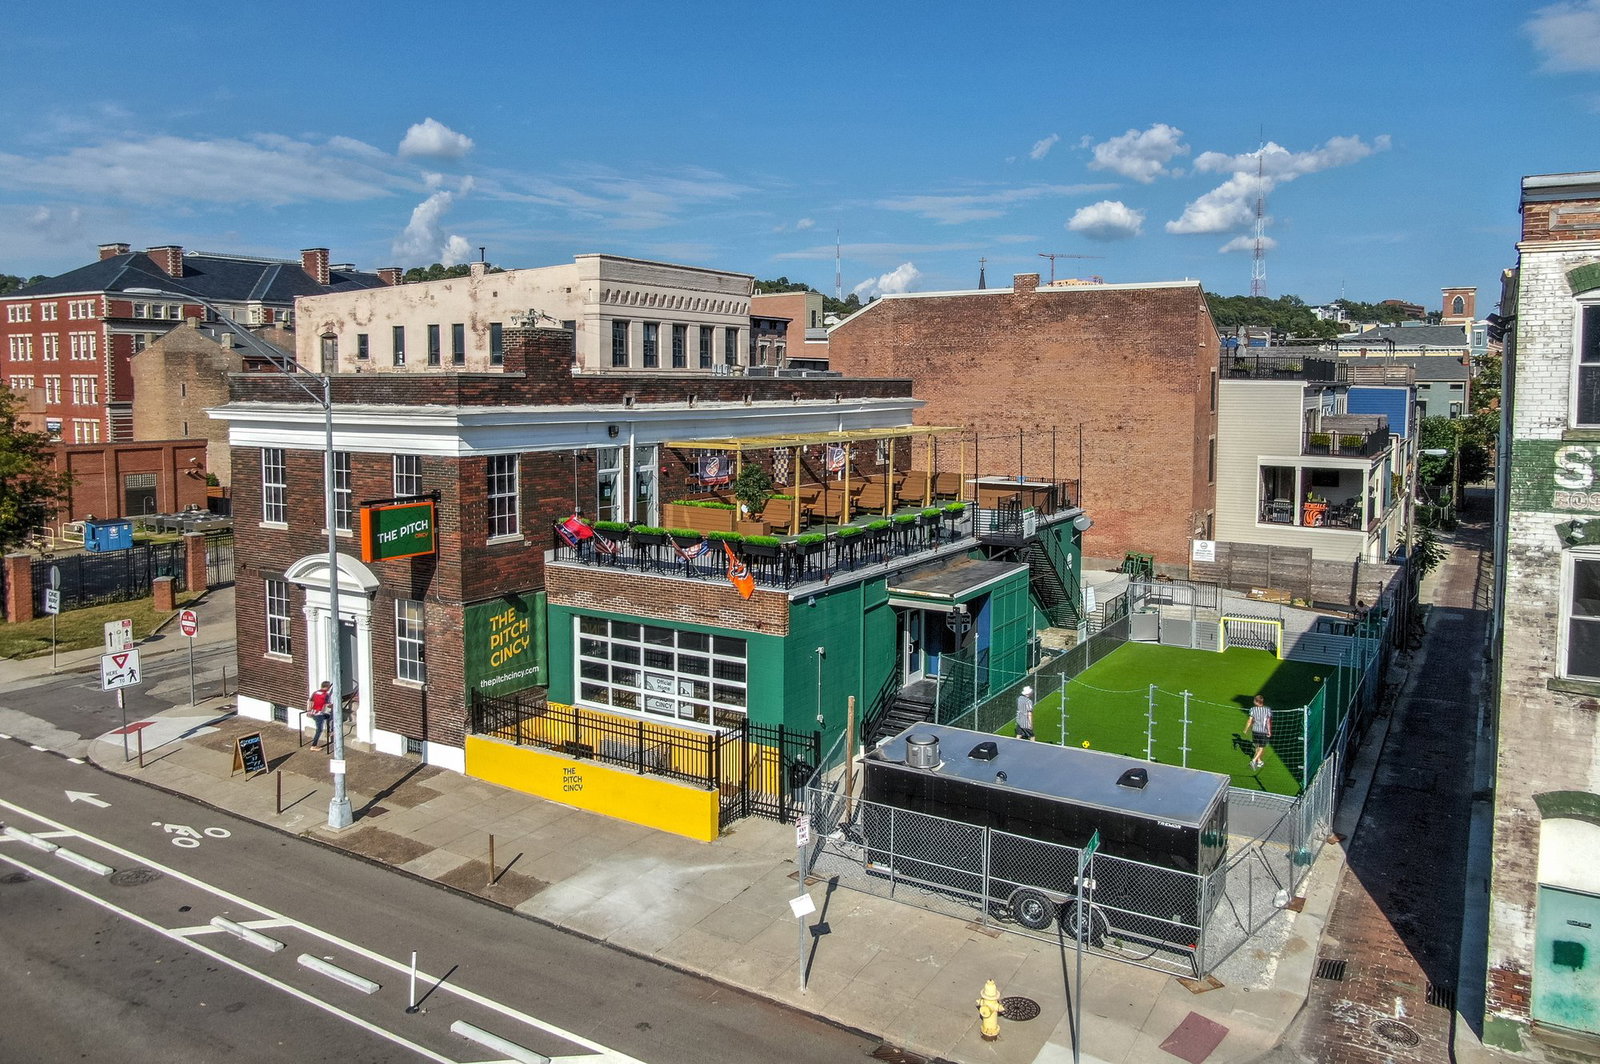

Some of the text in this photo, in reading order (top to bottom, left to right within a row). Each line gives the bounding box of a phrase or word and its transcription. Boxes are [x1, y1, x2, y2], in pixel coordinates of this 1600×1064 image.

[377, 519, 429, 543] THE PITCH
[489, 607, 516, 631] THE
[490, 618, 529, 650] PITCH
[490, 635, 530, 667] CINCY
[480, 665, 540, 688] thepitchcincy.com
[656, 678, 672, 686] Official
[655, 701, 673, 709] CINCY
[563, 767, 576, 775] THE
[563, 784, 583, 792] CINCY
